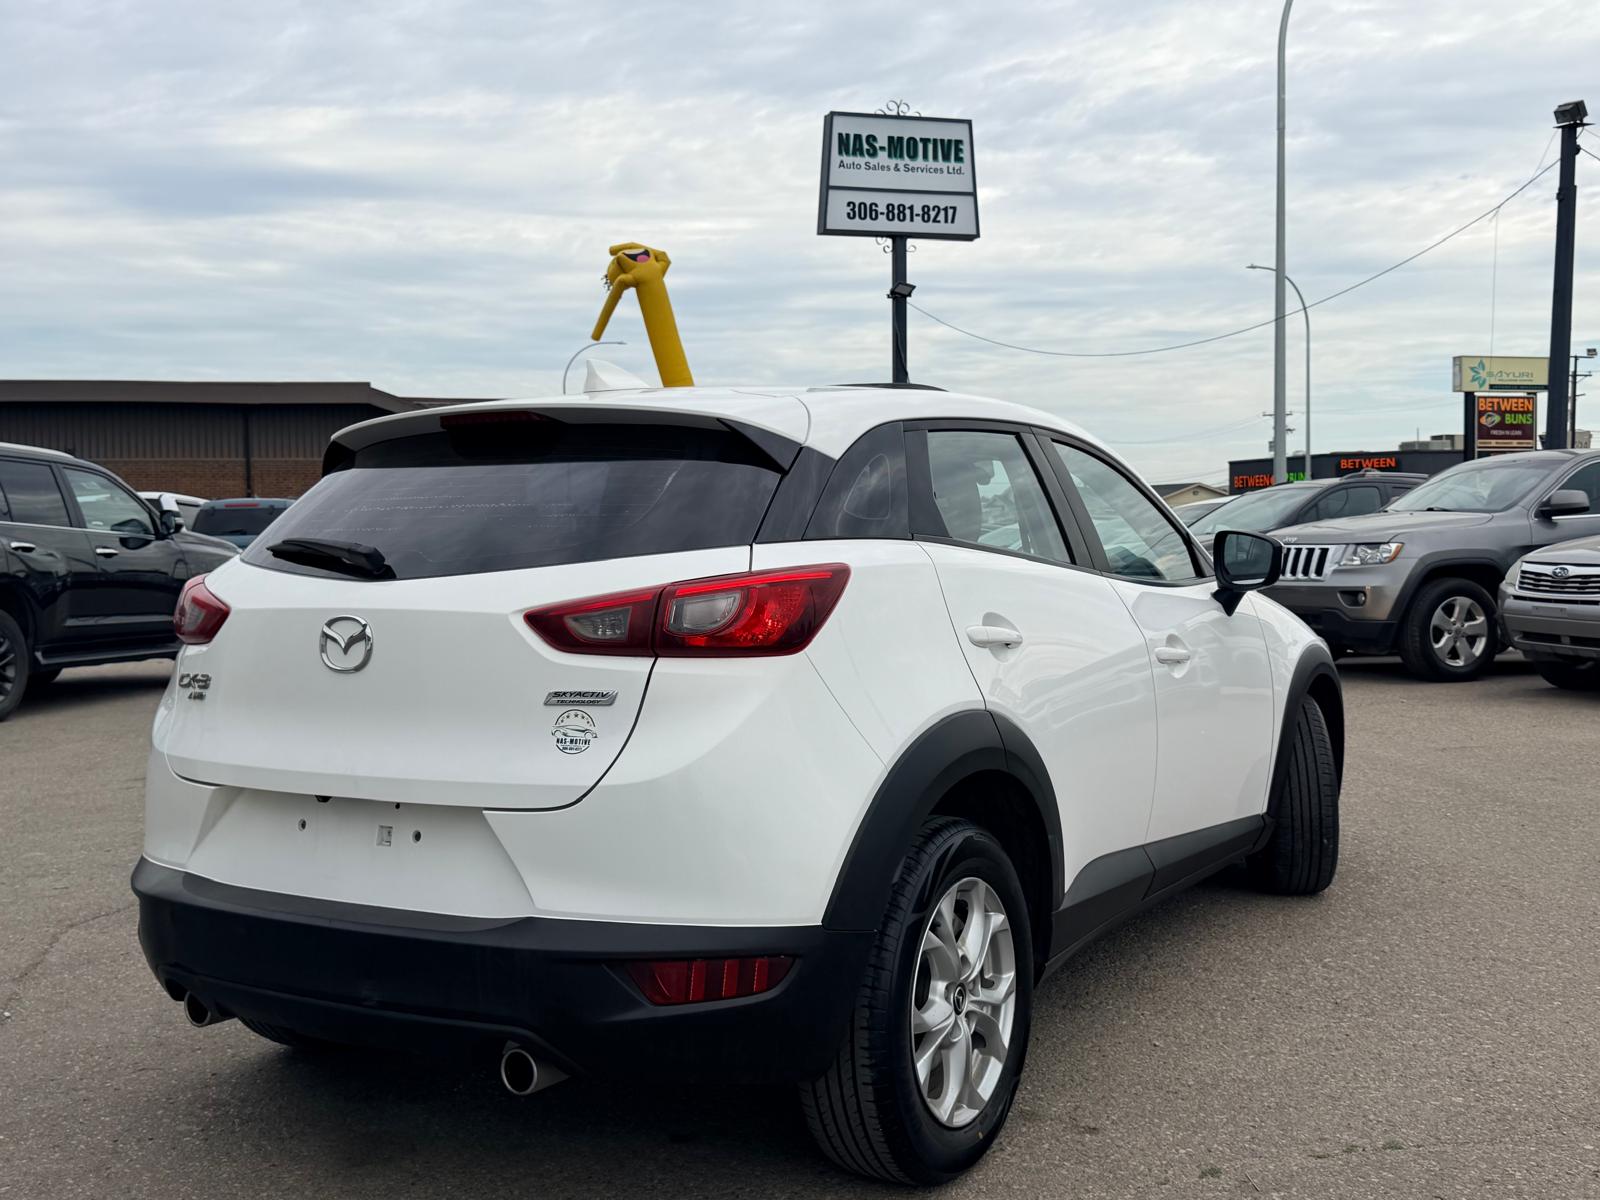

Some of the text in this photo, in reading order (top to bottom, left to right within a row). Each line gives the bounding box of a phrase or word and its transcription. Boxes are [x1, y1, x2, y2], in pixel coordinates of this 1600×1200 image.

[838, 132, 964, 163] NAS-MOTIVE
[838, 160, 965, 175] Auto Sales & Services Ltd.
[846, 201, 957, 224] 306-881-8217
[1478, 398, 1533, 411] BETWEEN
[1504, 413, 1533, 425] BUNS
[1340, 457, 1396, 469] BETWEEN
[1234, 473, 1272, 488] BETWEEN
[556, 737, 591, 745] NAS-MOTIVE
